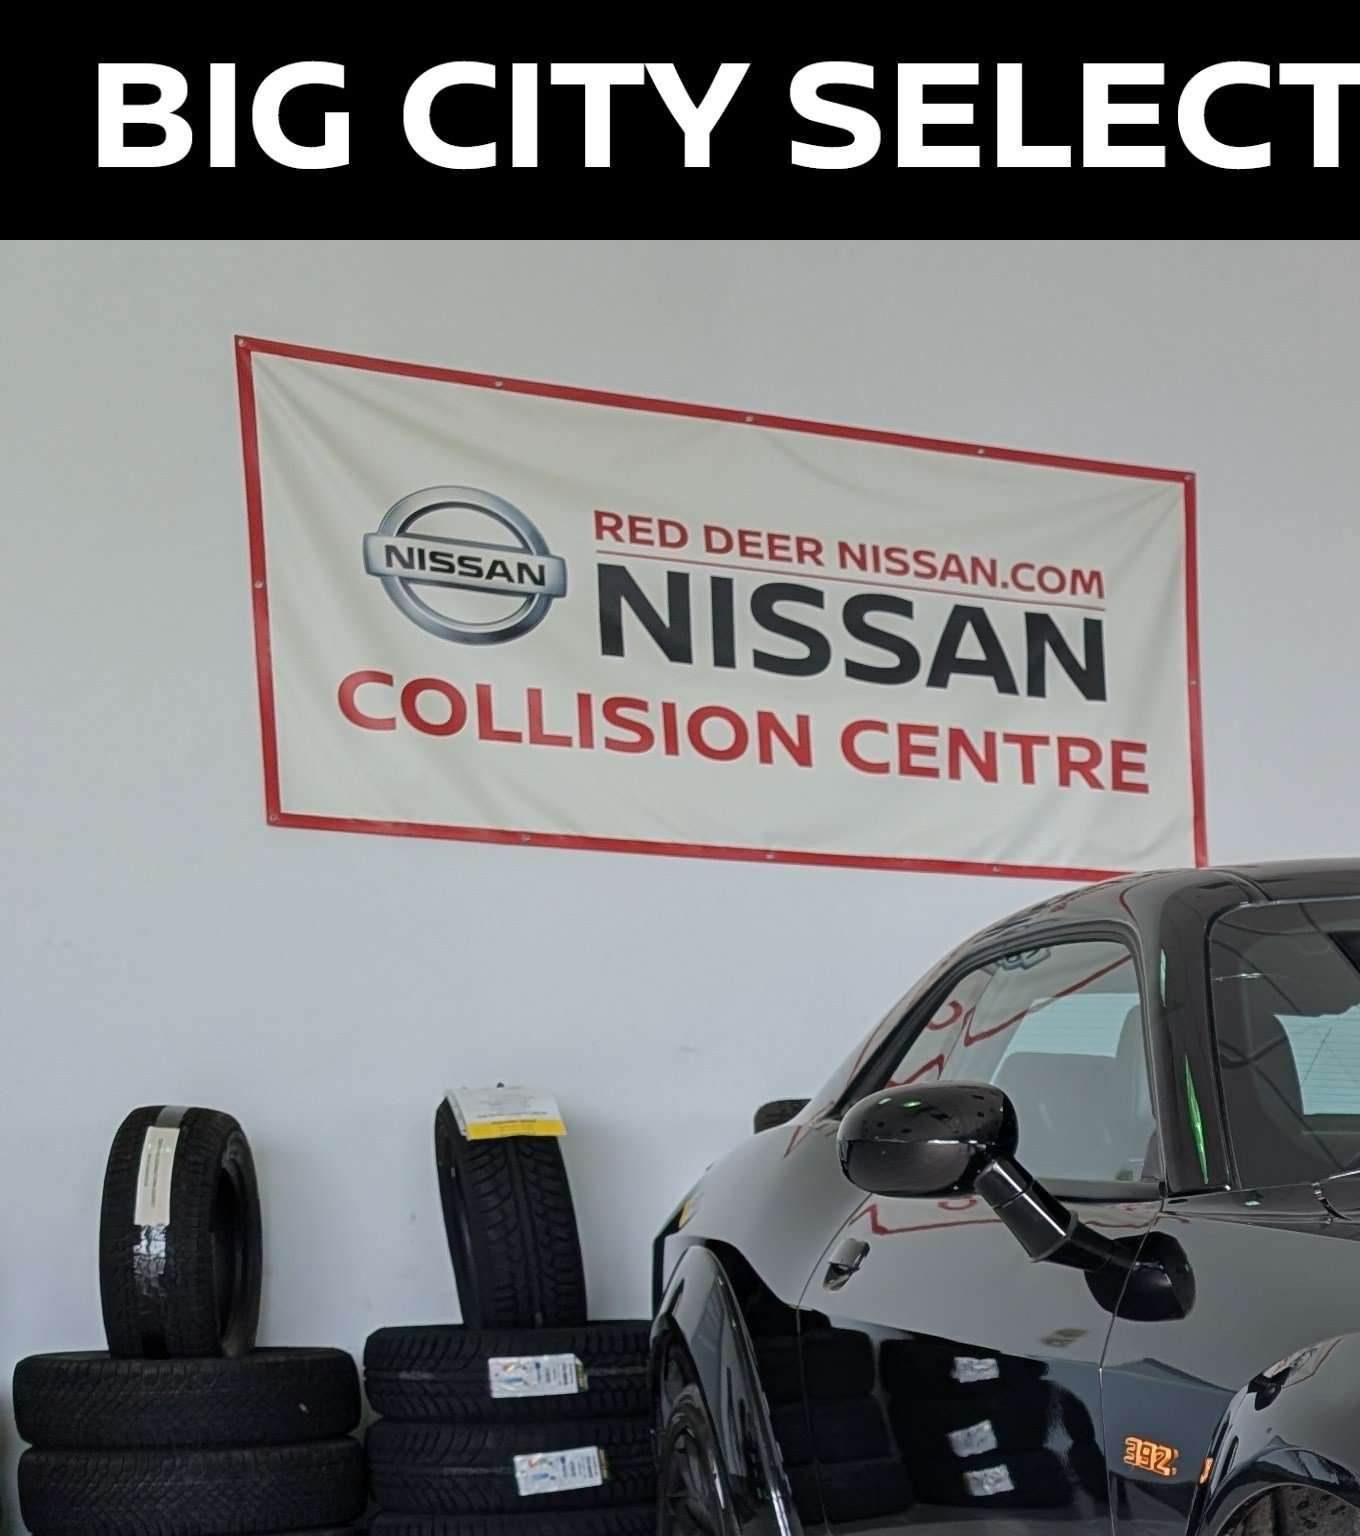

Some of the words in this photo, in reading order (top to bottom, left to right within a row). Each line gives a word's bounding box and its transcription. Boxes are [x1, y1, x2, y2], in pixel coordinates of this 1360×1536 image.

[384, 543, 546, 587] NISSAN
[594, 510, 689, 549] RED
[703, 525, 824, 567] DEER
[837, 541, 1106, 599] NISSAN.COM
[597, 563, 1107, 702] NISSAN
[337, 670, 813, 769] COLLISION
[840, 718, 1150, 795] CENTRE
[1123, 1436, 1180, 1476] 392
